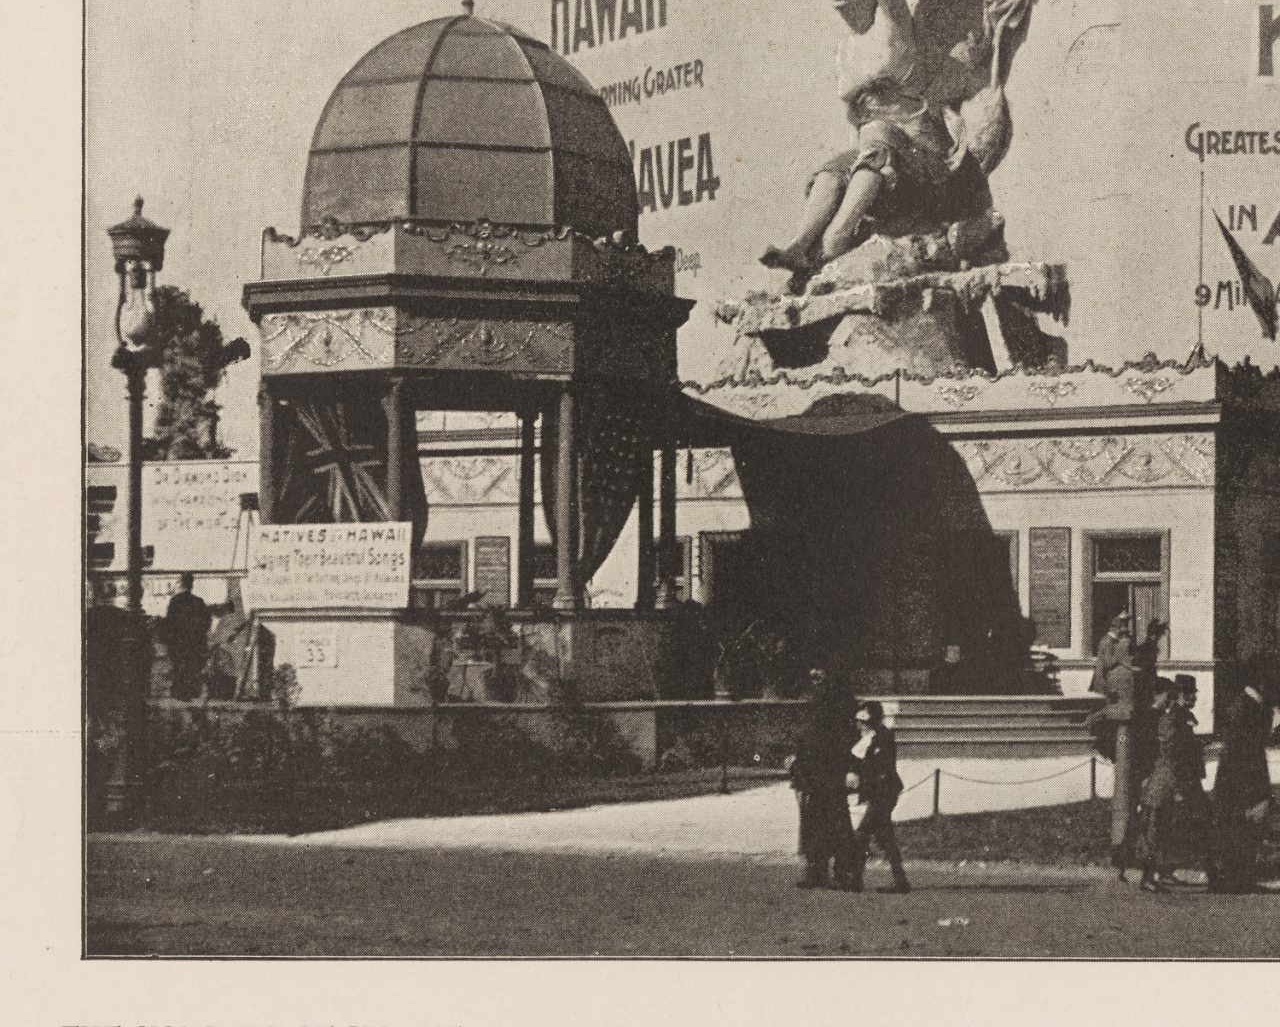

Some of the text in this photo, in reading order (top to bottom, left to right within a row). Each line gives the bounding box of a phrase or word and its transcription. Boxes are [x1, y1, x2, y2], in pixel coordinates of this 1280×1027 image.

[1229, 204, 1258, 231] IN
[1195, 284, 1211, 307] 9
[261, 528, 327, 544] NATIVES
[347, 527, 407, 542] HAWAII
